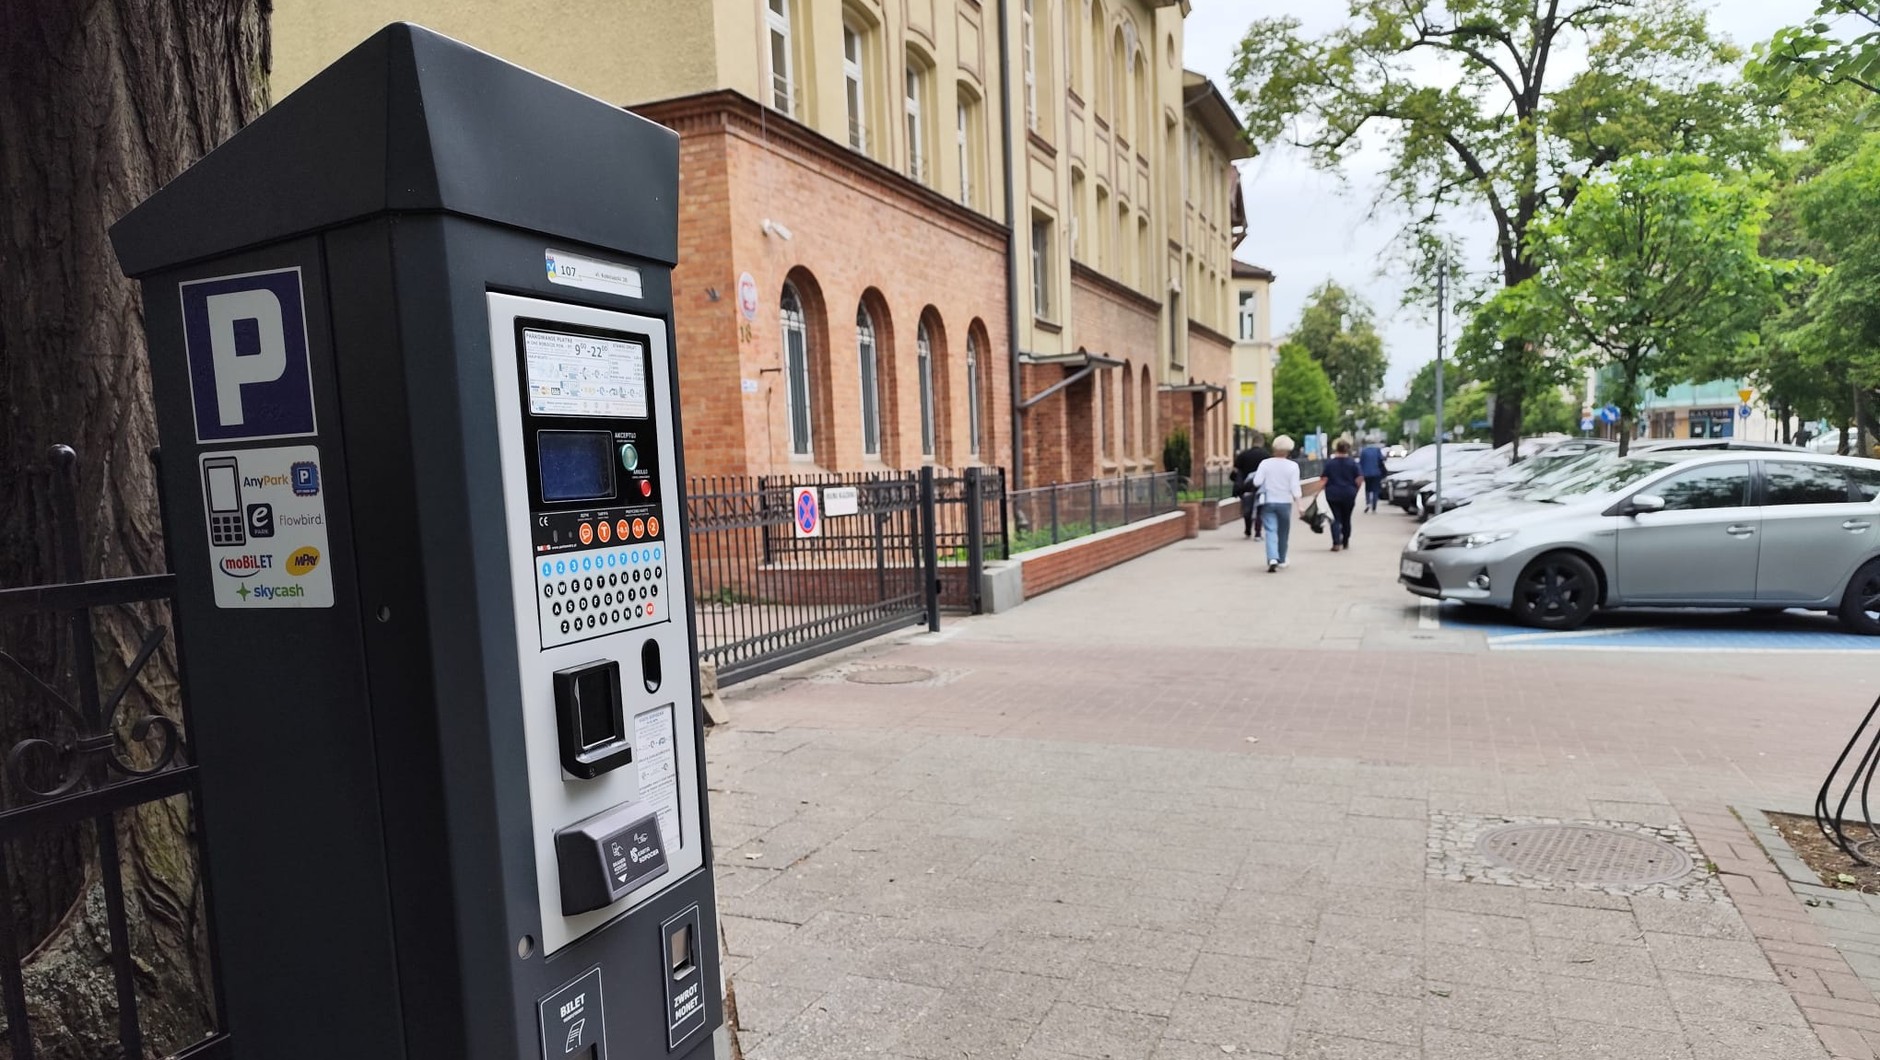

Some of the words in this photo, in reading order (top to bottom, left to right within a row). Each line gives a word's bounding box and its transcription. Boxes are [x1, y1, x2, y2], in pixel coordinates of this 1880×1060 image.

[560, 265, 576, 276] 107
[206, 288, 287, 426] P
[244, 474, 289, 488] AnyPark
[300, 470, 308, 483] P
[252, 506, 268, 527] e
[600, 526, 607, 536] T
[254, 584, 304, 600] skycash
[560, 993, 585, 1018] BILET
[674, 982, 698, 1008] ZWROT
[675, 996, 698, 1020] MONET
